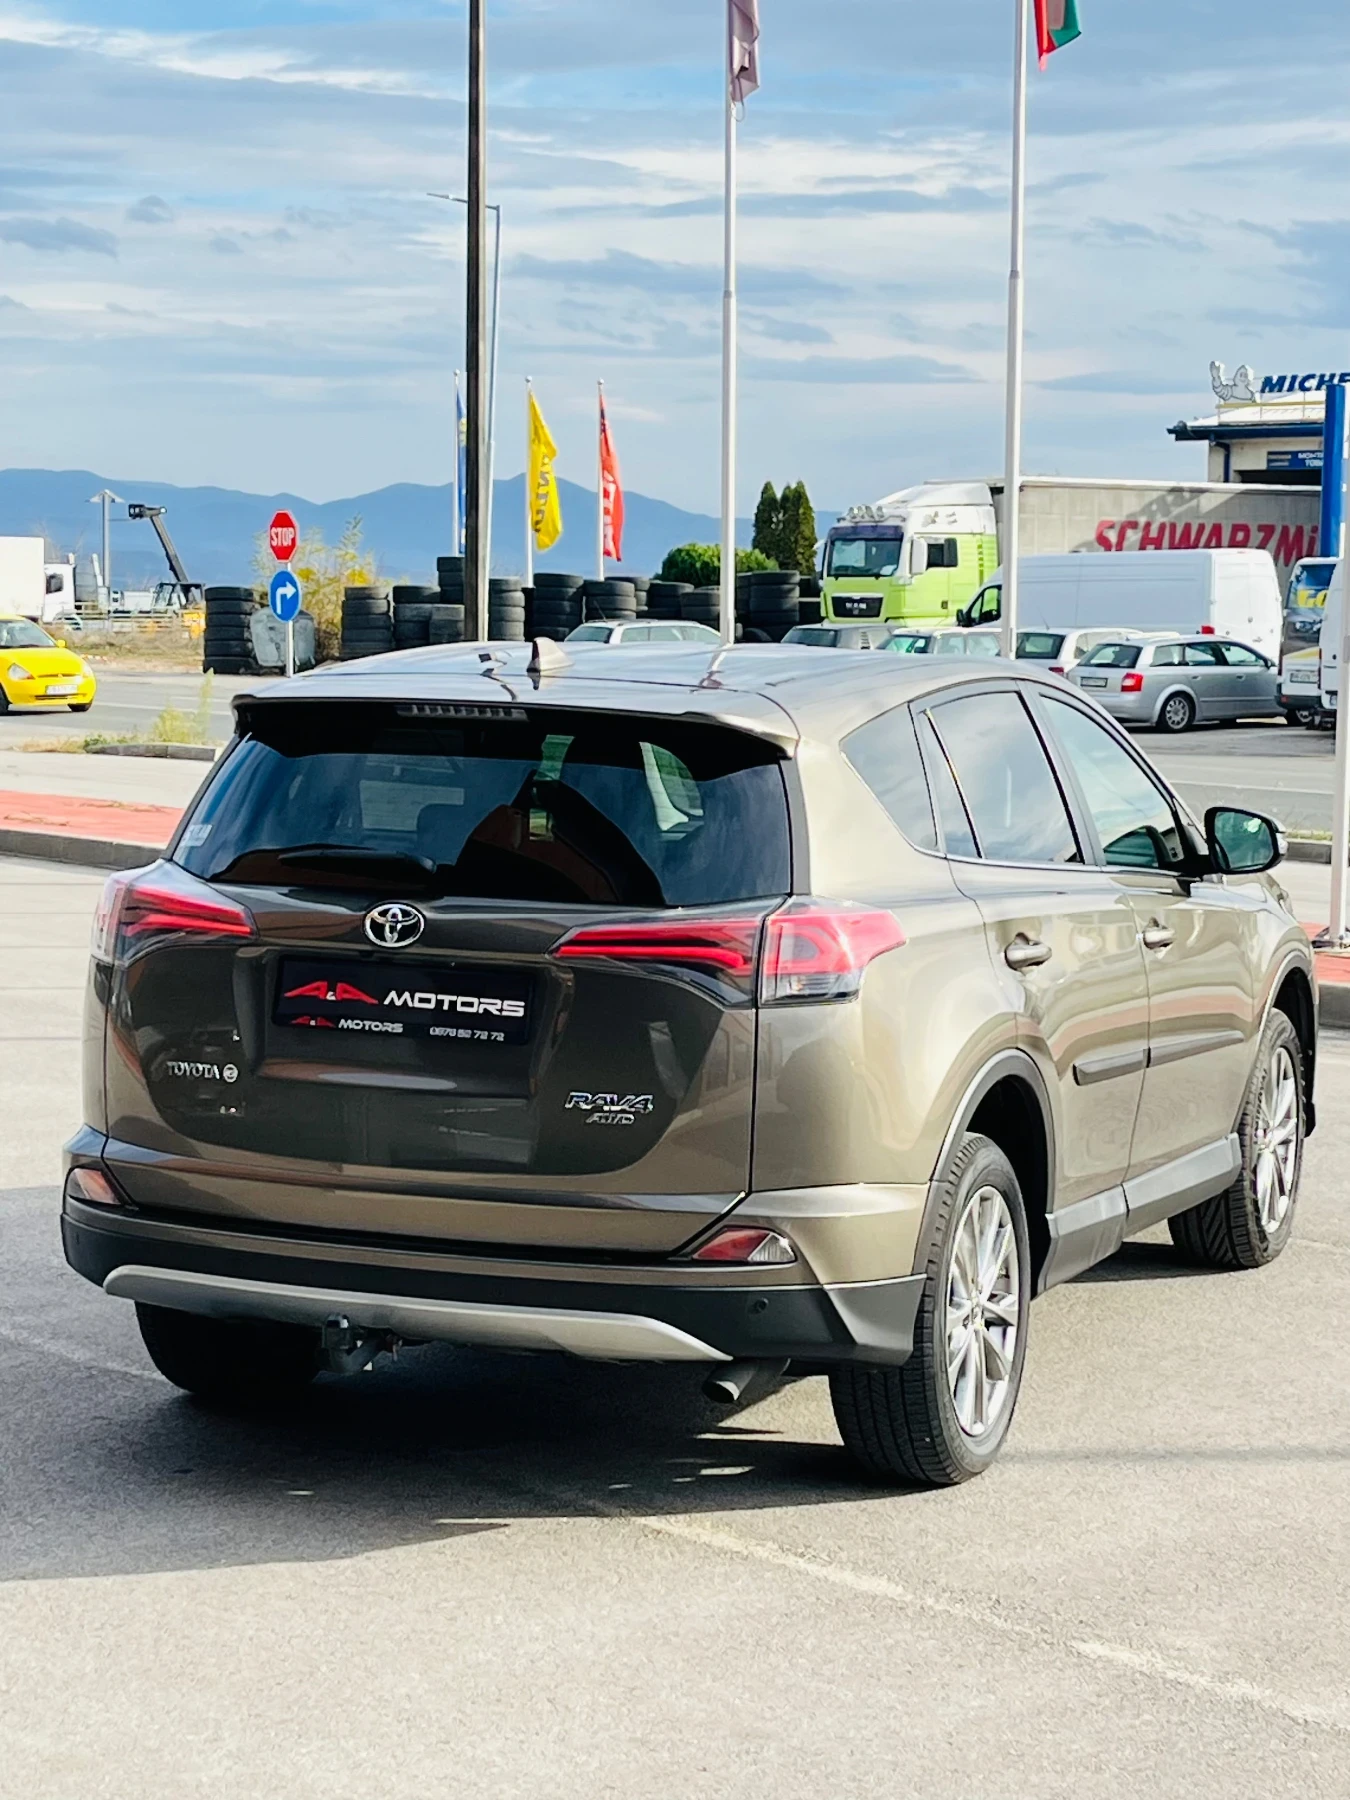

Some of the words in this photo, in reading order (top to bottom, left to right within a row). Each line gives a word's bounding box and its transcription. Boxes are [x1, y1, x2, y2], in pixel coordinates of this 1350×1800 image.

[270, 527, 295, 547] STOP
[384, 990, 526, 1018] MOTORS
[338, 1018, 404, 1034] MOTORS
[166, 1061, 220, 1080] TOYOTA
[564, 1091, 654, 1114] RAV4
